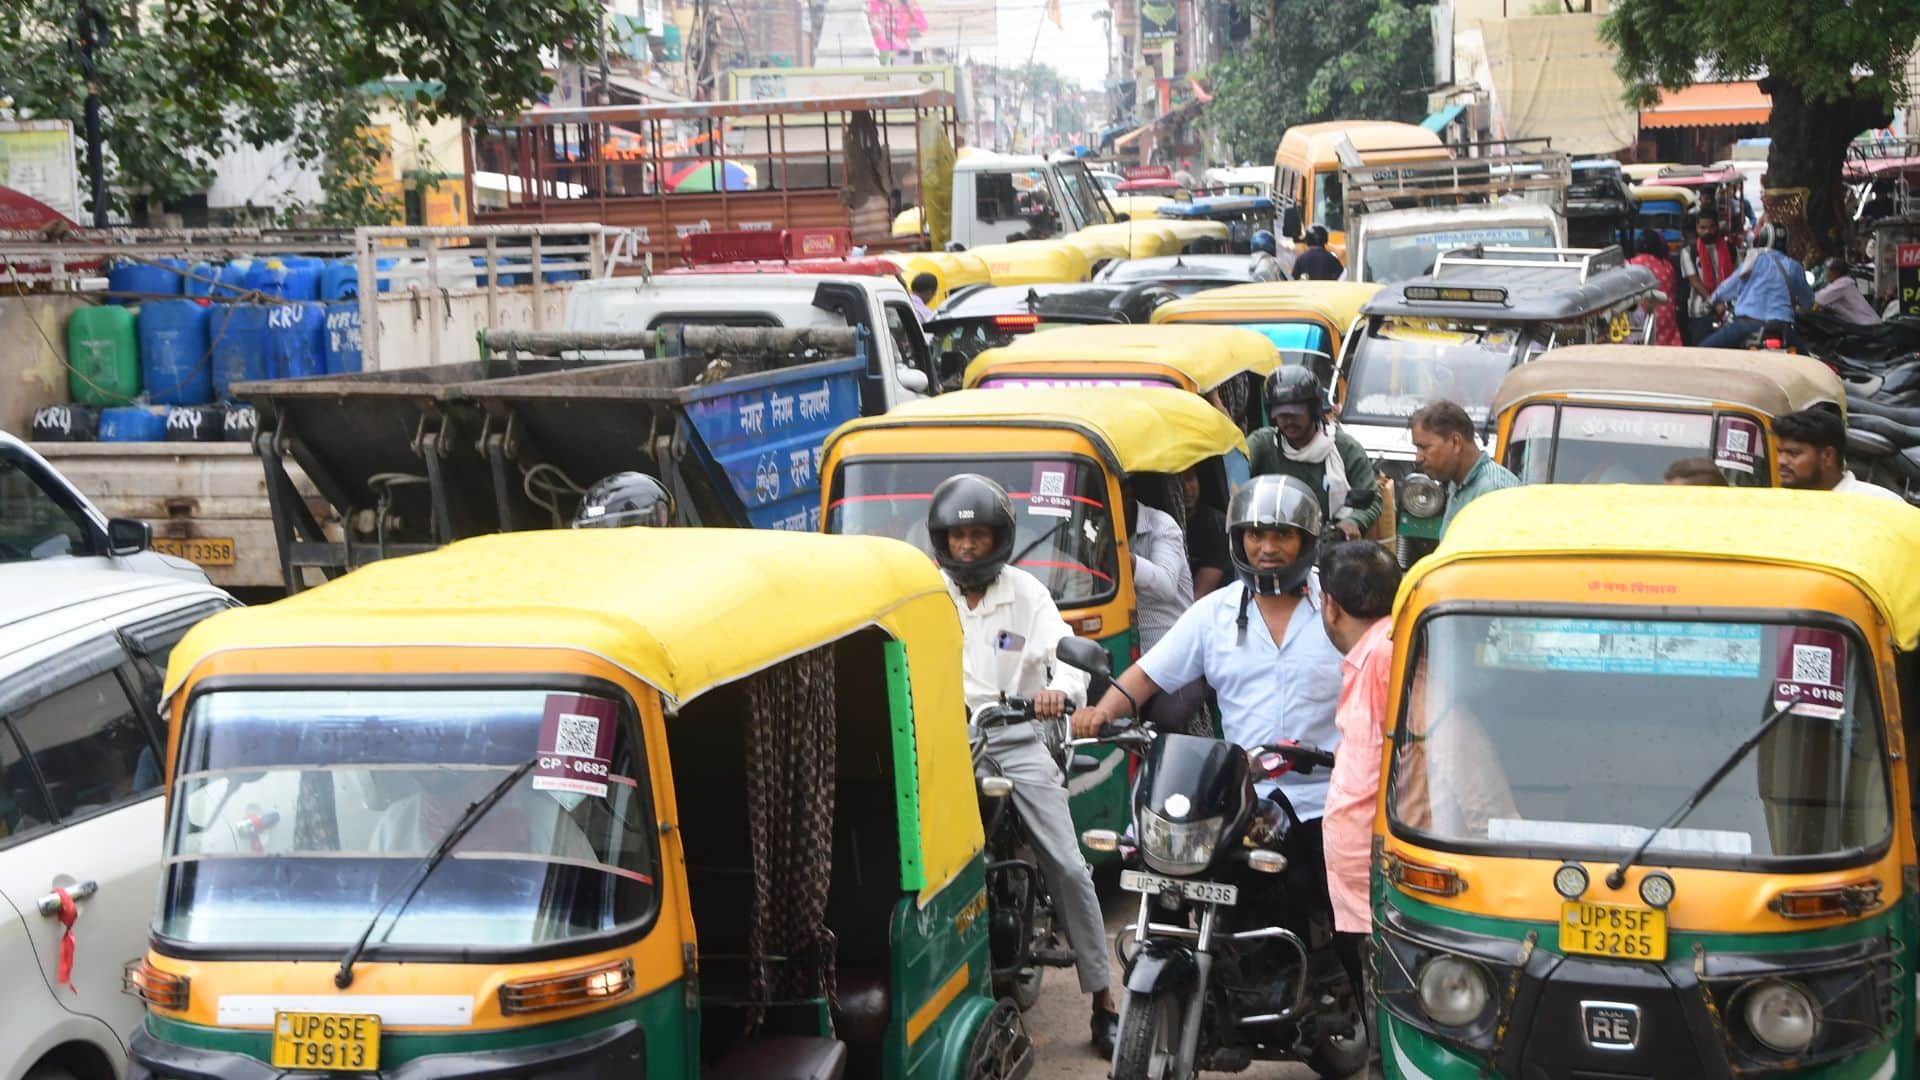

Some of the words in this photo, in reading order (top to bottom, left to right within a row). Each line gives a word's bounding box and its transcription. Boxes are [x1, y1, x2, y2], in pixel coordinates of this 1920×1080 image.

[268, 304, 304, 329] KRU
[739, 402, 765, 435] नगर
[770, 391, 794, 428] निगम
[1031, 496, 1045, 504] CP
[1778, 683, 1800, 696] CP
[1811, 687, 1844, 703] 0188
[539, 757, 562, 770] CP
[573, 760, 609, 777] 0682
[1580, 905, 1652, 932] UP65F
[1580, 929, 1652, 956] T3265
[292, 1015, 366, 1041] UP65E
[1592, 1016, 1631, 1041] RE
[292, 1041, 365, 1067] T9913
